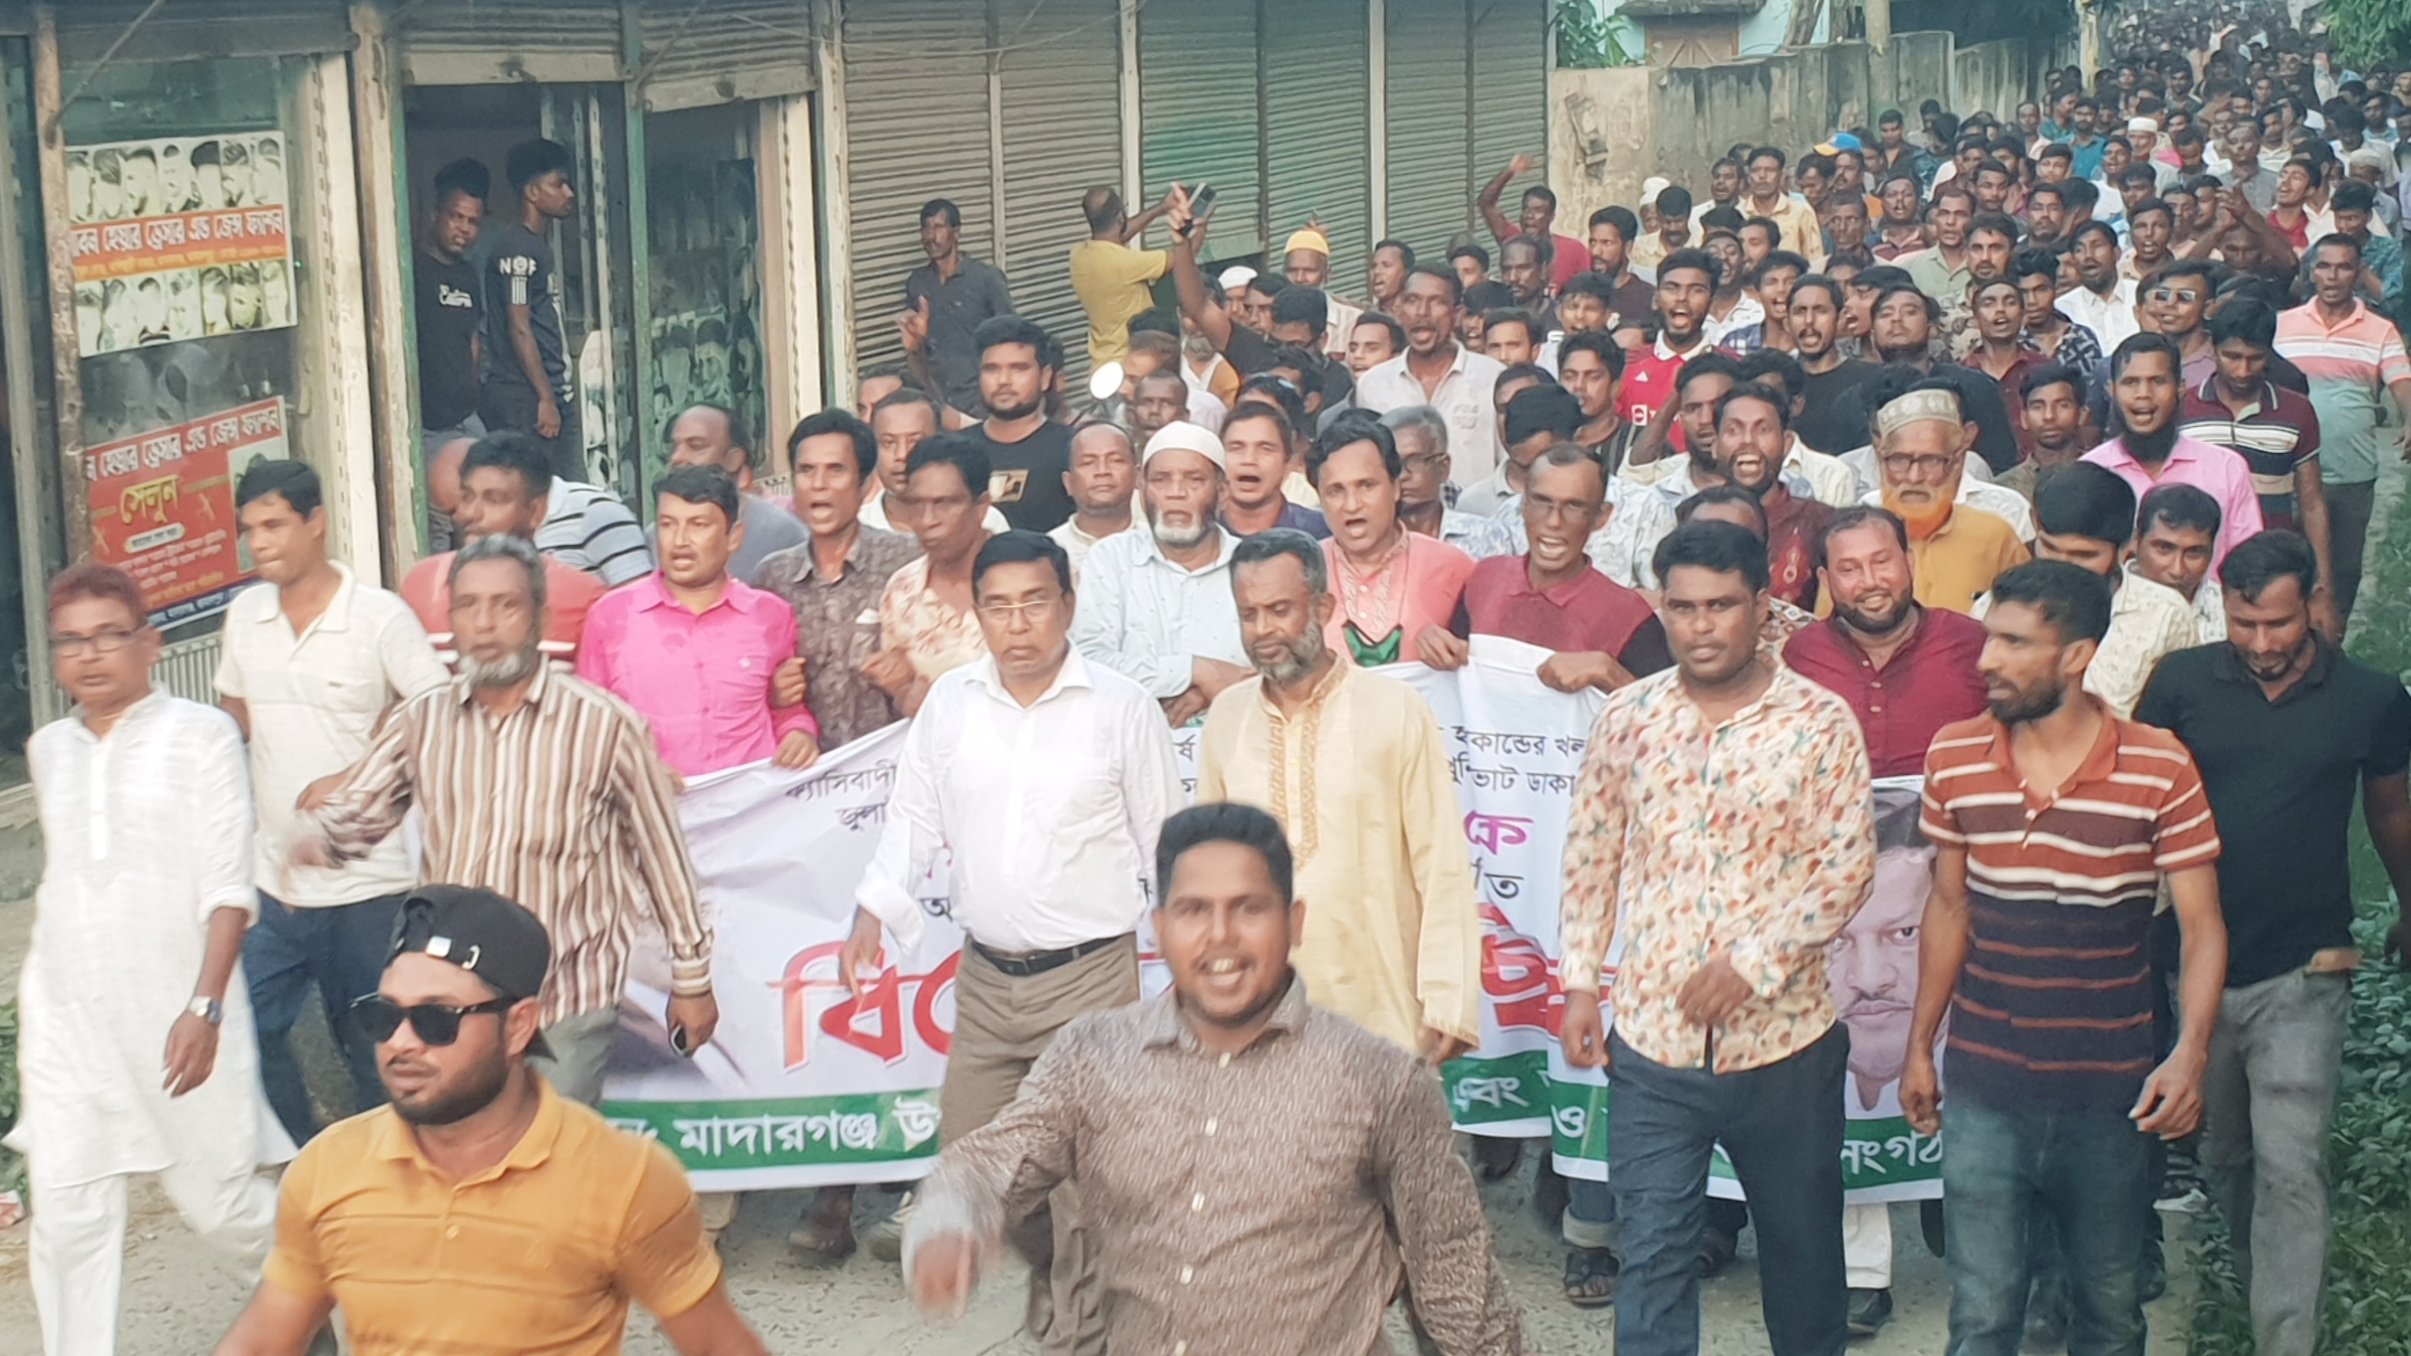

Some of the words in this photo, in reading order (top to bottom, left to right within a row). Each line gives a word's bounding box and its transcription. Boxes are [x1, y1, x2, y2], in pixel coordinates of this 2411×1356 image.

[120, 474, 181, 525] সেলুন
[1526, 772, 1576, 797] ডাকা
[672, 1108, 879, 1158] মাদারগঞ্জ
[890, 1096, 943, 1144] উ
